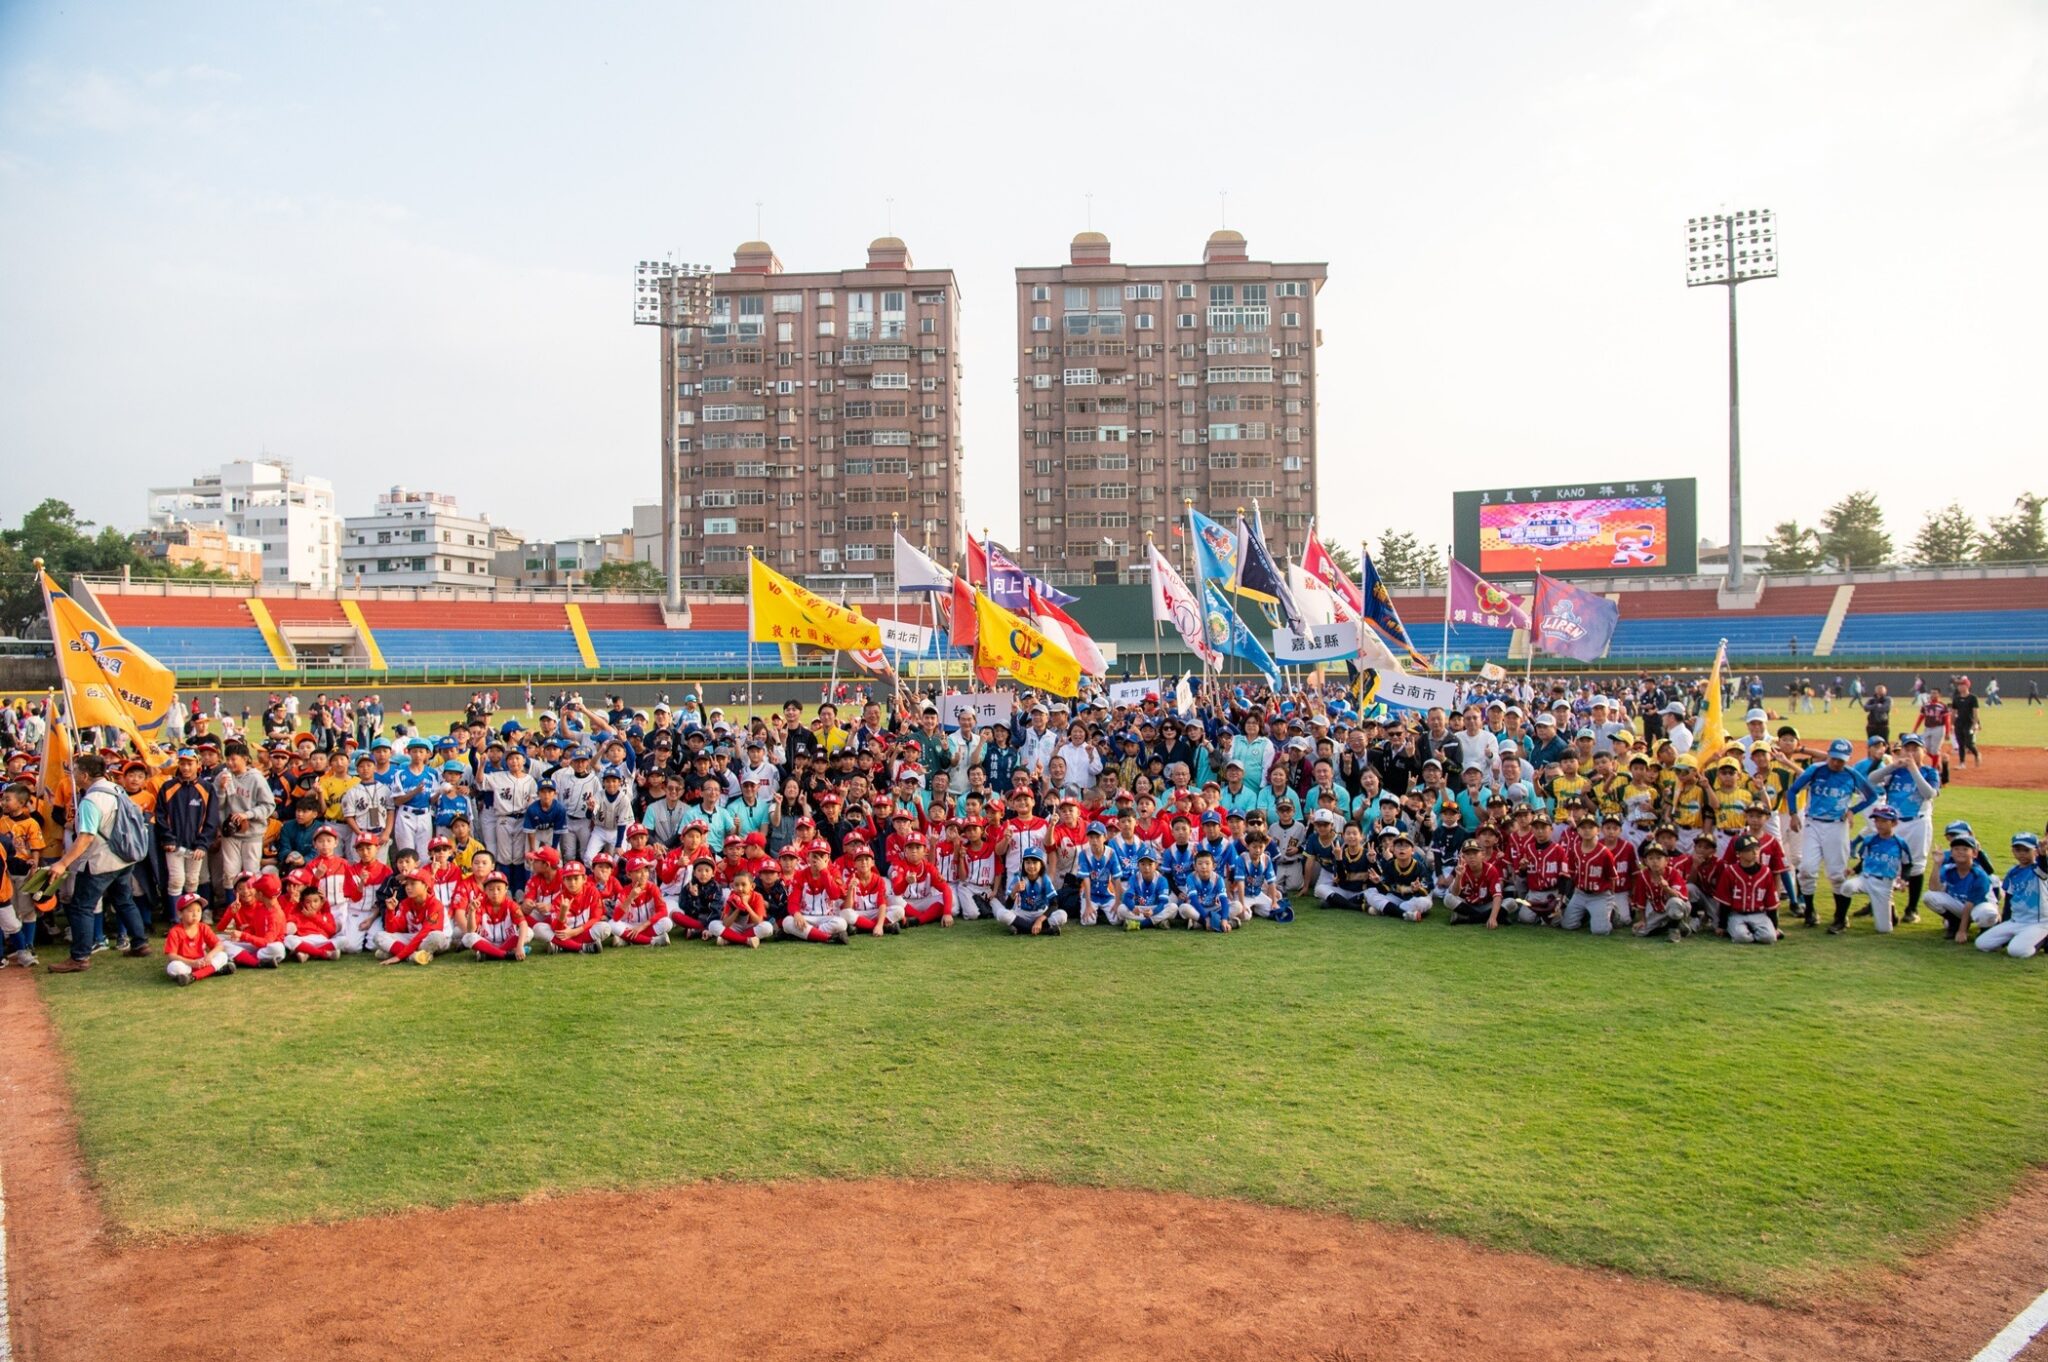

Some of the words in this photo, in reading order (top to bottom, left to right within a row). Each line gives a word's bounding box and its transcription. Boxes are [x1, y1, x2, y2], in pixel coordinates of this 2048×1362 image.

[1557, 488, 1586, 499] KANO
[993, 577, 1022, 594] 向上
[1543, 617, 1584, 638] LIREN
[887, 629, 918, 644] 新北市
[1392, 681, 1436, 701] 台南市
